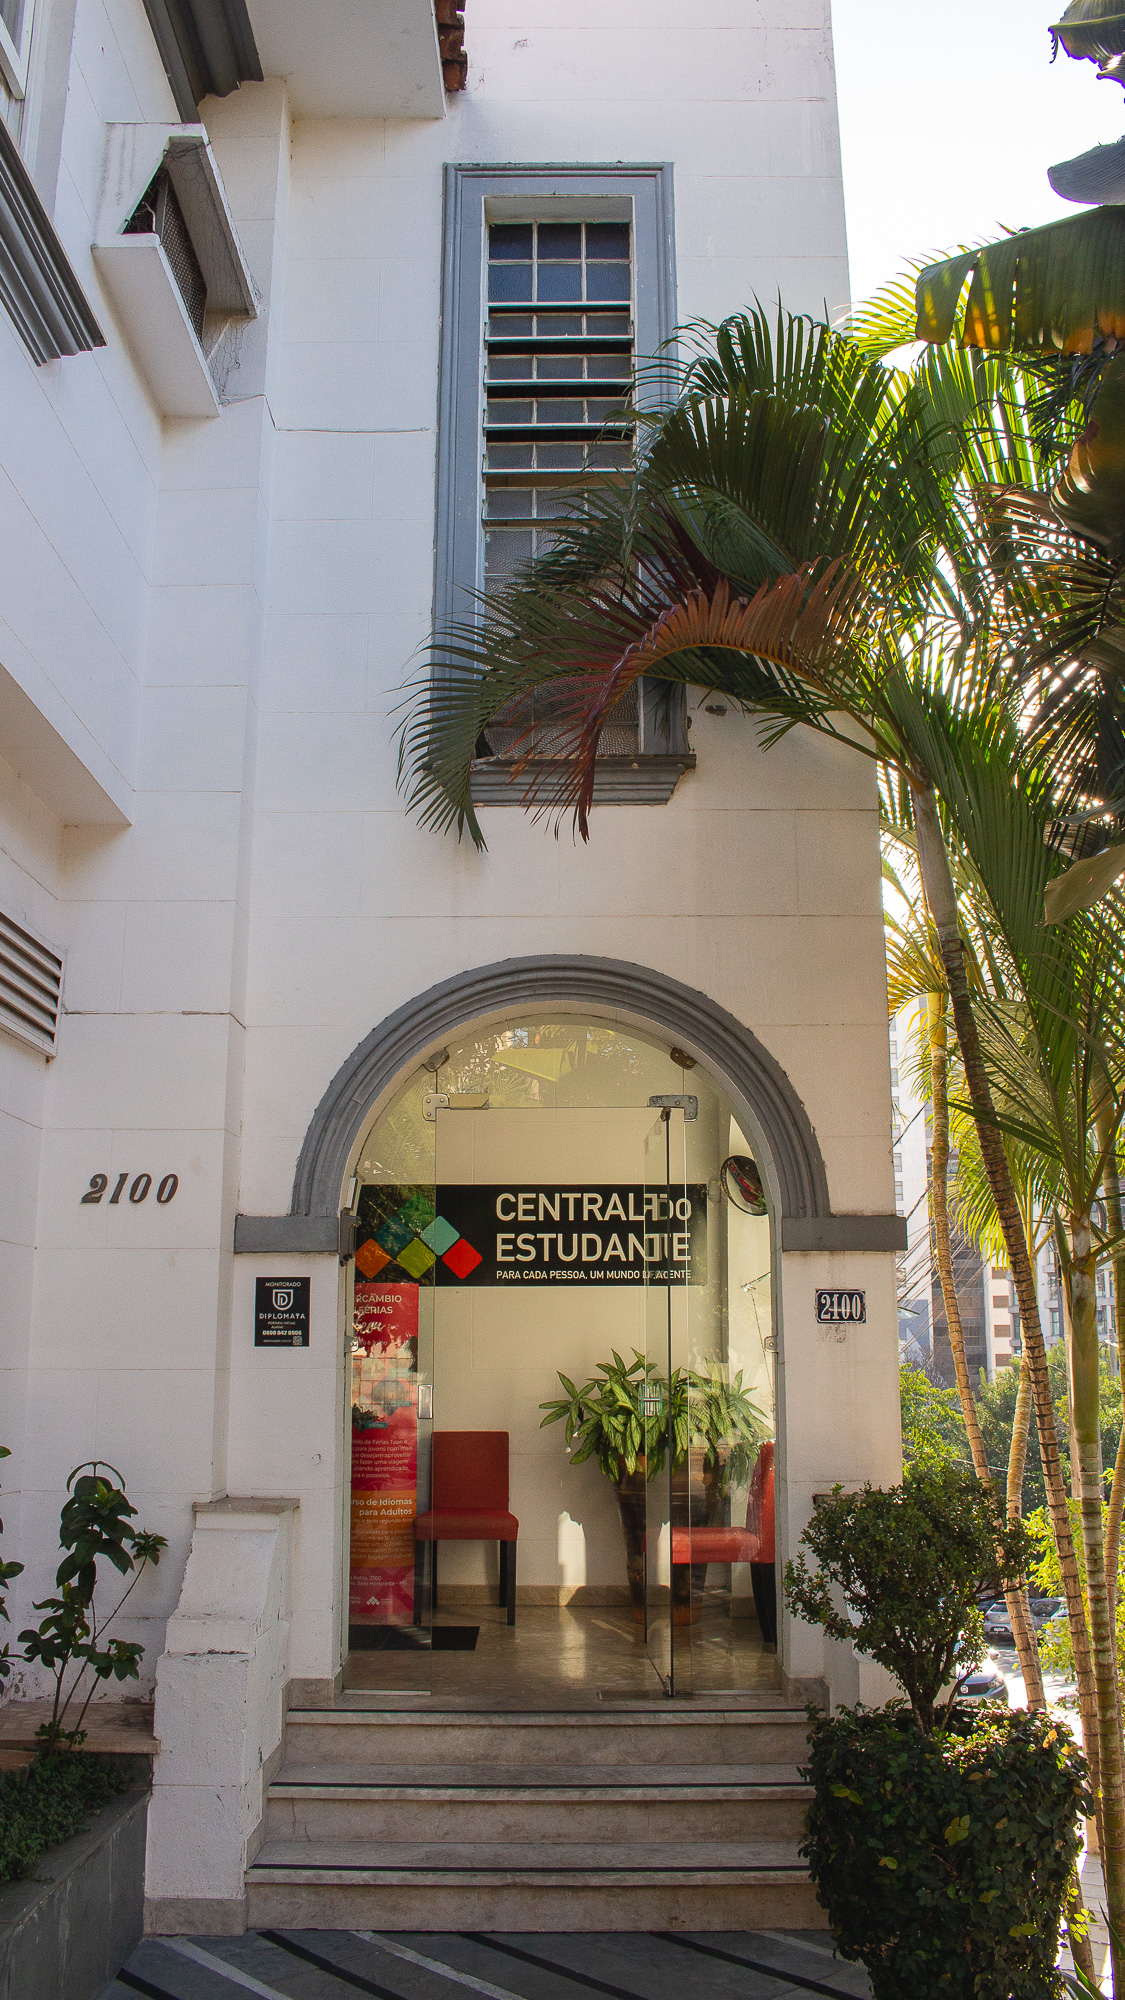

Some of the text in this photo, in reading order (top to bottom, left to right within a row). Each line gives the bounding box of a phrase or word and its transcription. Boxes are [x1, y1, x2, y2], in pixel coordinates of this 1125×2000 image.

[81, 1173, 179, 1204] 2100
[496, 1193, 645, 1221] CENTRAL
[496, 1270, 521, 1280] PARA
[523, 1270, 548, 1280] CADA
[550, 1270, 588, 1281] PESSOA,
[590, 1270, 605, 1280] UM
[606, 1270, 640, 1280] MUNDO
[820, 1294, 862, 1320] 2100
[379, 1497, 412, 1505] Idiomas
[380, 1507, 412, 1515] Adultos
